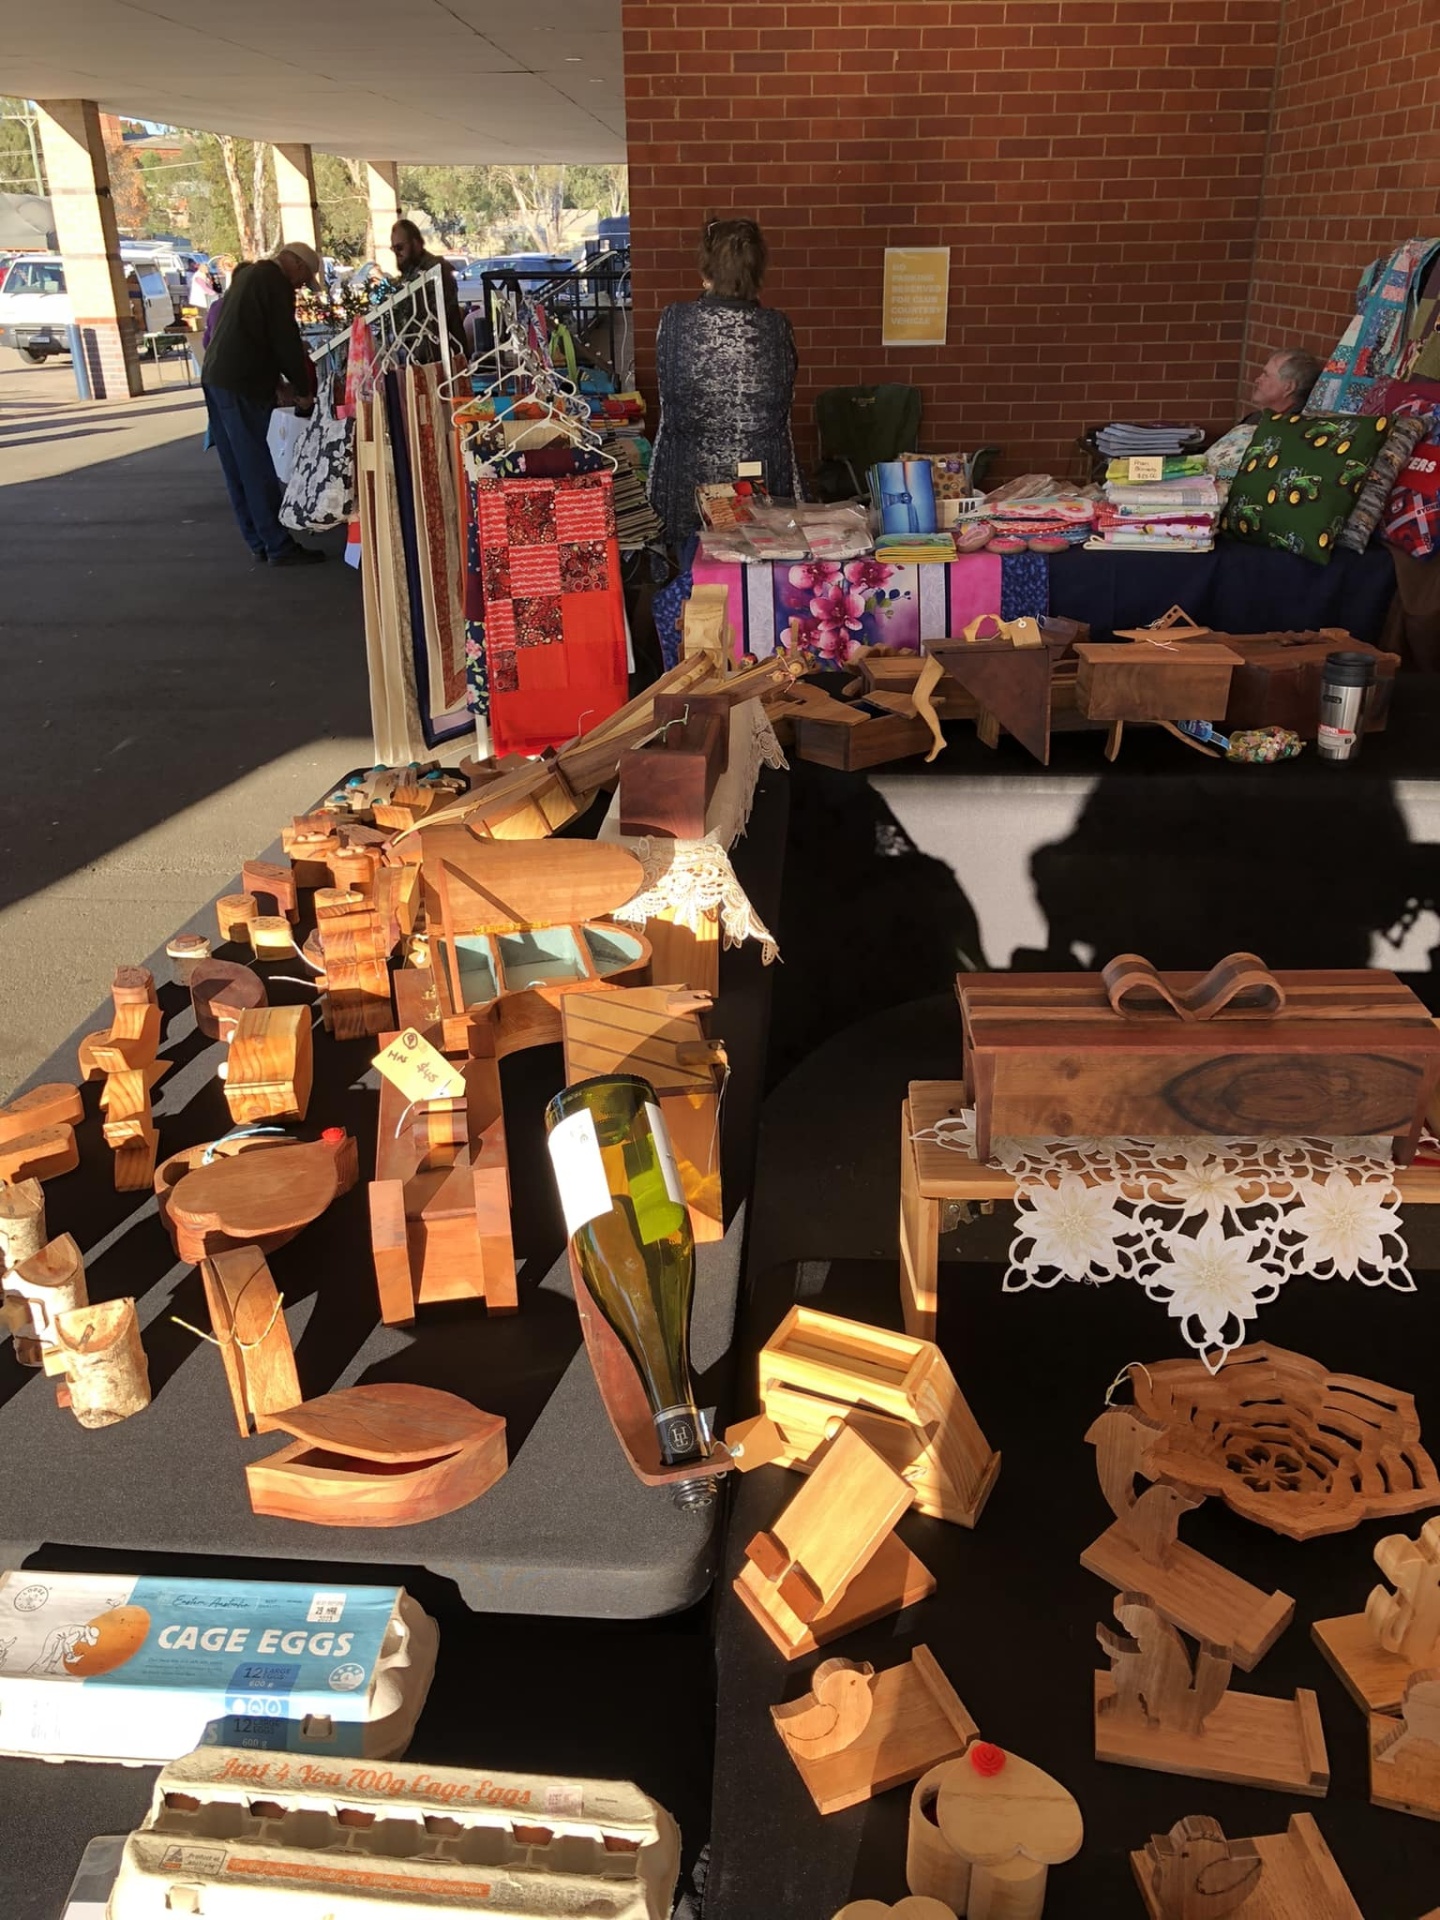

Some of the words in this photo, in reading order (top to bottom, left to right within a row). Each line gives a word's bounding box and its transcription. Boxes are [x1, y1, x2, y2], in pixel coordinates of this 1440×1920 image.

[158, 1625, 250, 1653] CAGE
[257, 1629, 354, 1657] EGGS
[243, 1667, 262, 1679] 12
[234, 1718, 252, 1733] 12
[212, 1758, 270, 1780] Just
[273, 1763, 290, 1782] 4
[298, 1764, 342, 1786] You
[346, 1768, 406, 1797] 700g
[411, 1774, 470, 1802] Cage
[475, 1780, 532, 1807] Eggs
